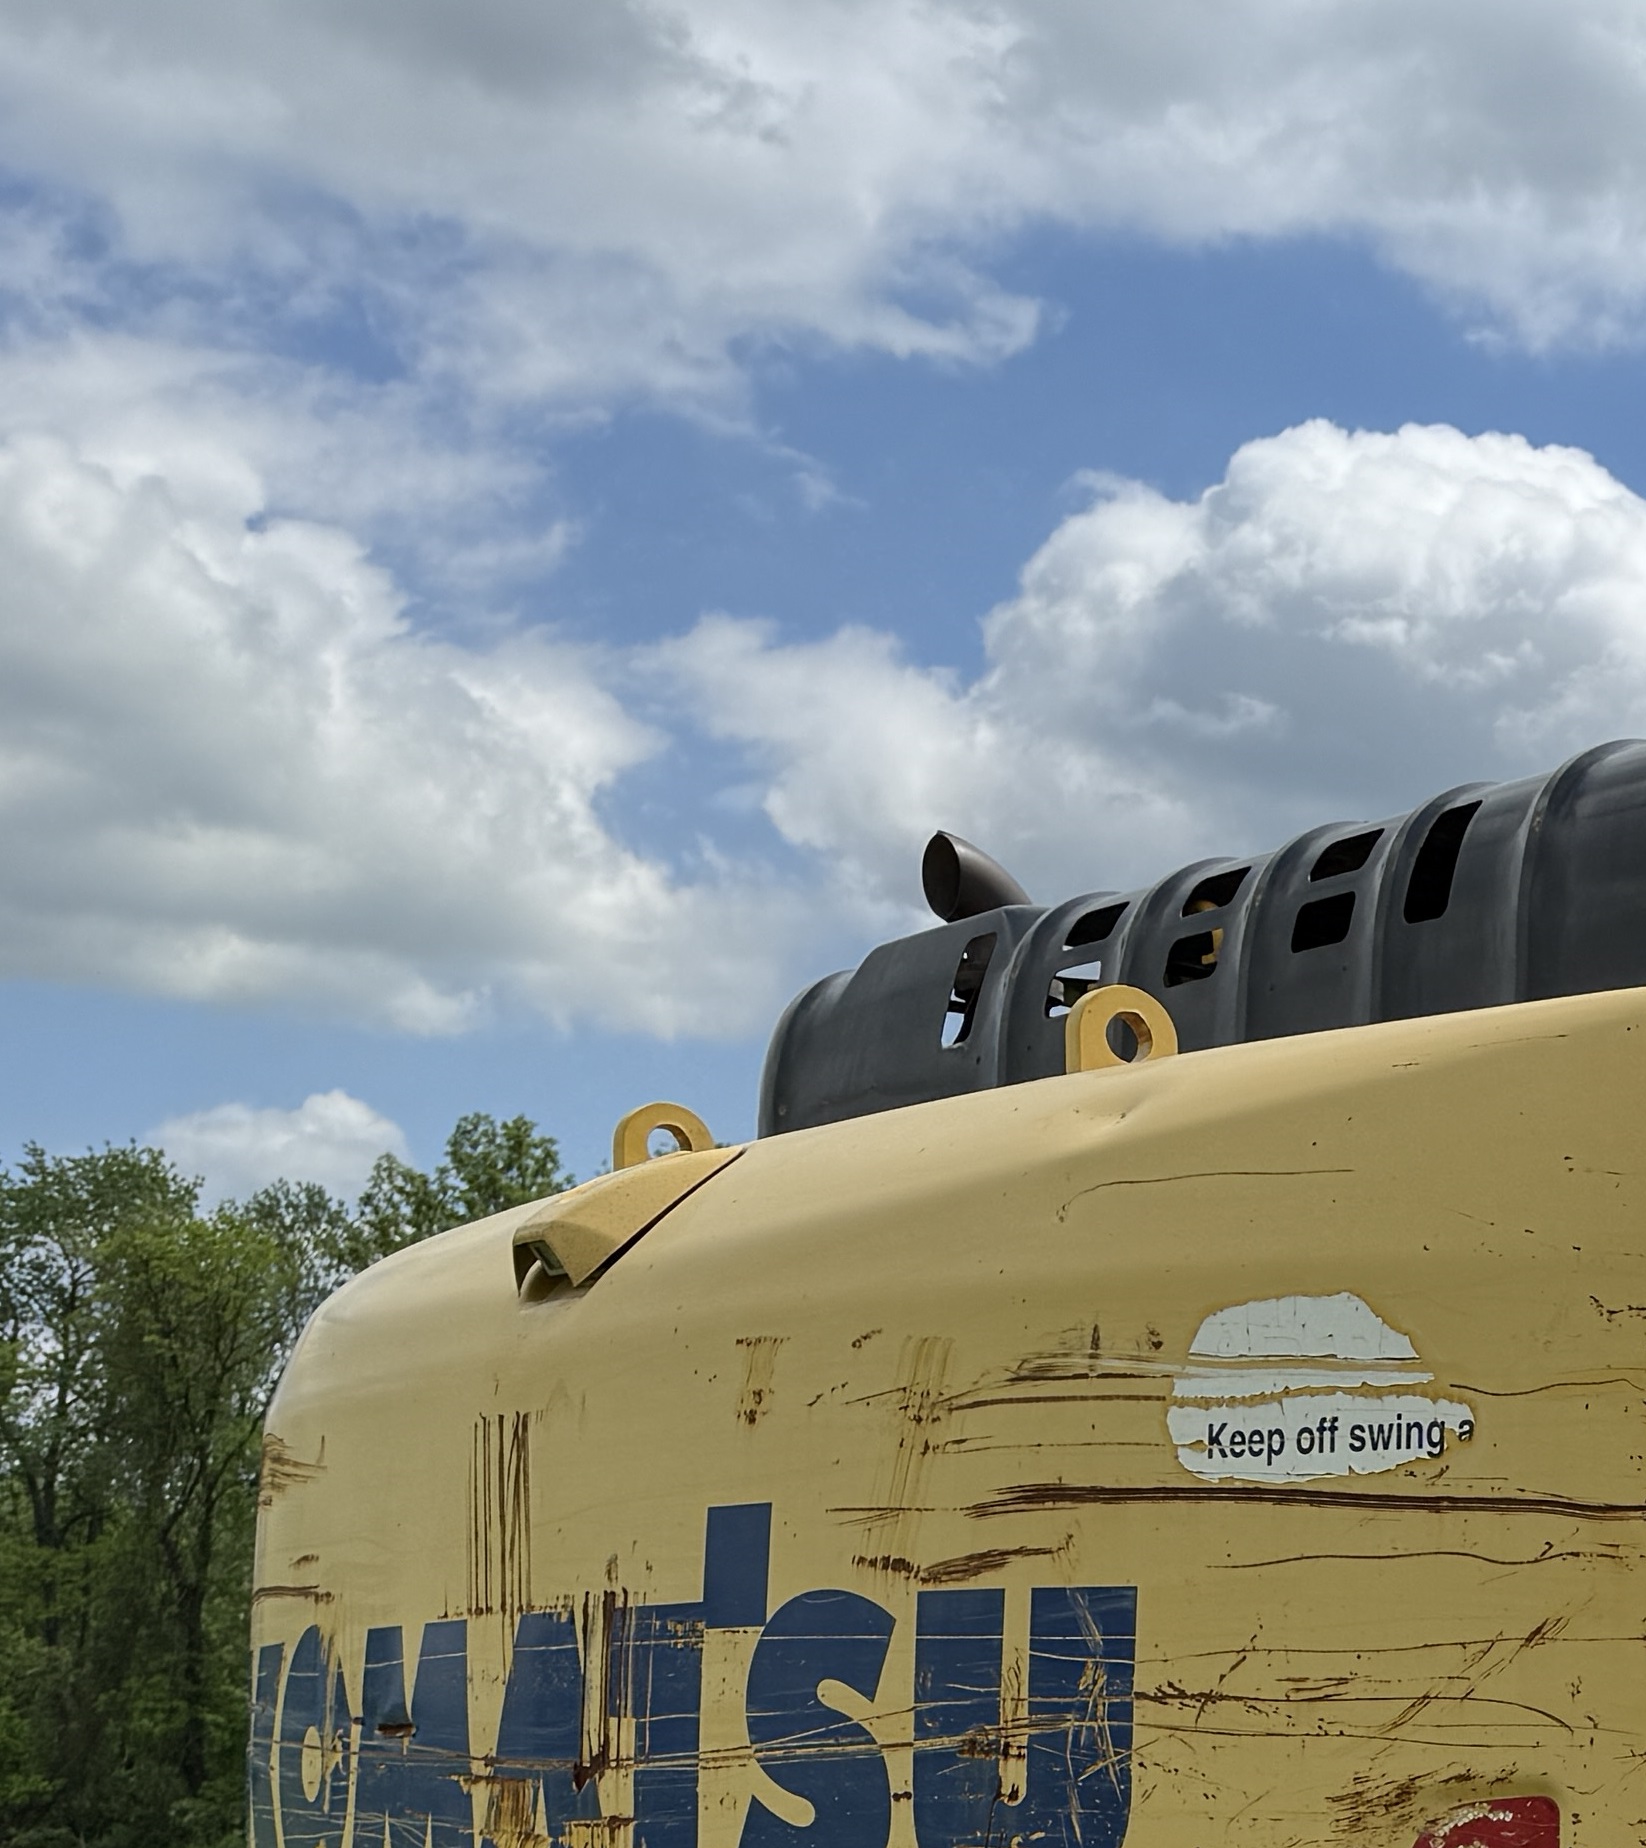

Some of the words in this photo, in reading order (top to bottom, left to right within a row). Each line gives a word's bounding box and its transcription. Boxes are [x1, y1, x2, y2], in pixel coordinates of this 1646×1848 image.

[1207, 1422, 1285, 1466] Keep
[1295, 1416, 1339, 1456] off
[1348, 1412, 1446, 1458] swing
